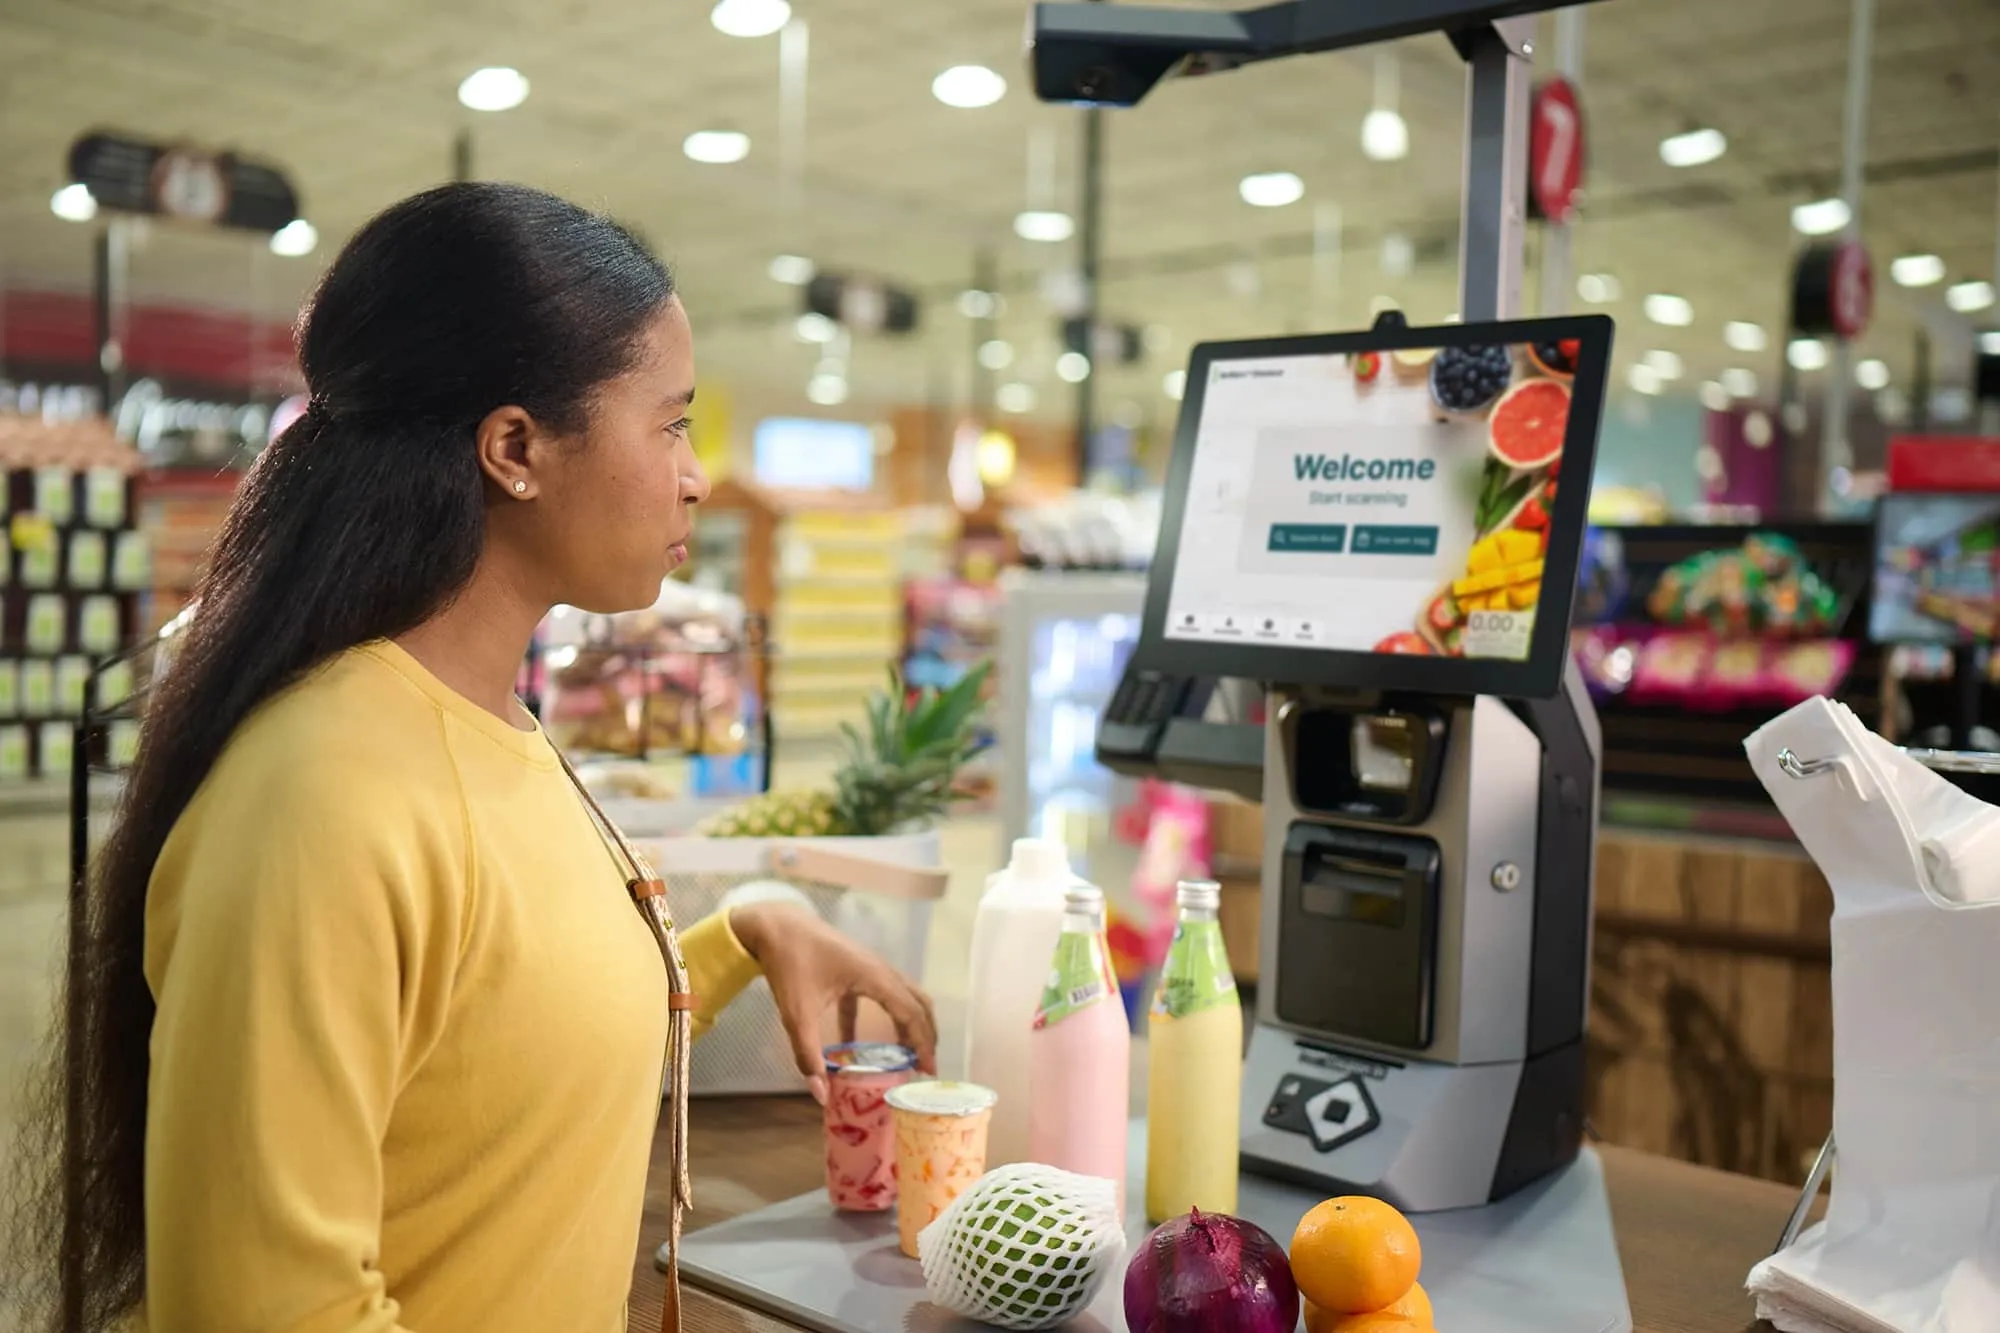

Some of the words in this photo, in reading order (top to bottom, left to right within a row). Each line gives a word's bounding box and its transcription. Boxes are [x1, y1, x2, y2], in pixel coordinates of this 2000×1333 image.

[1294, 453, 1436, 481] Welcome
[1309, 490, 1343, 505] Start
[1345, 491, 1408, 508] scanning
